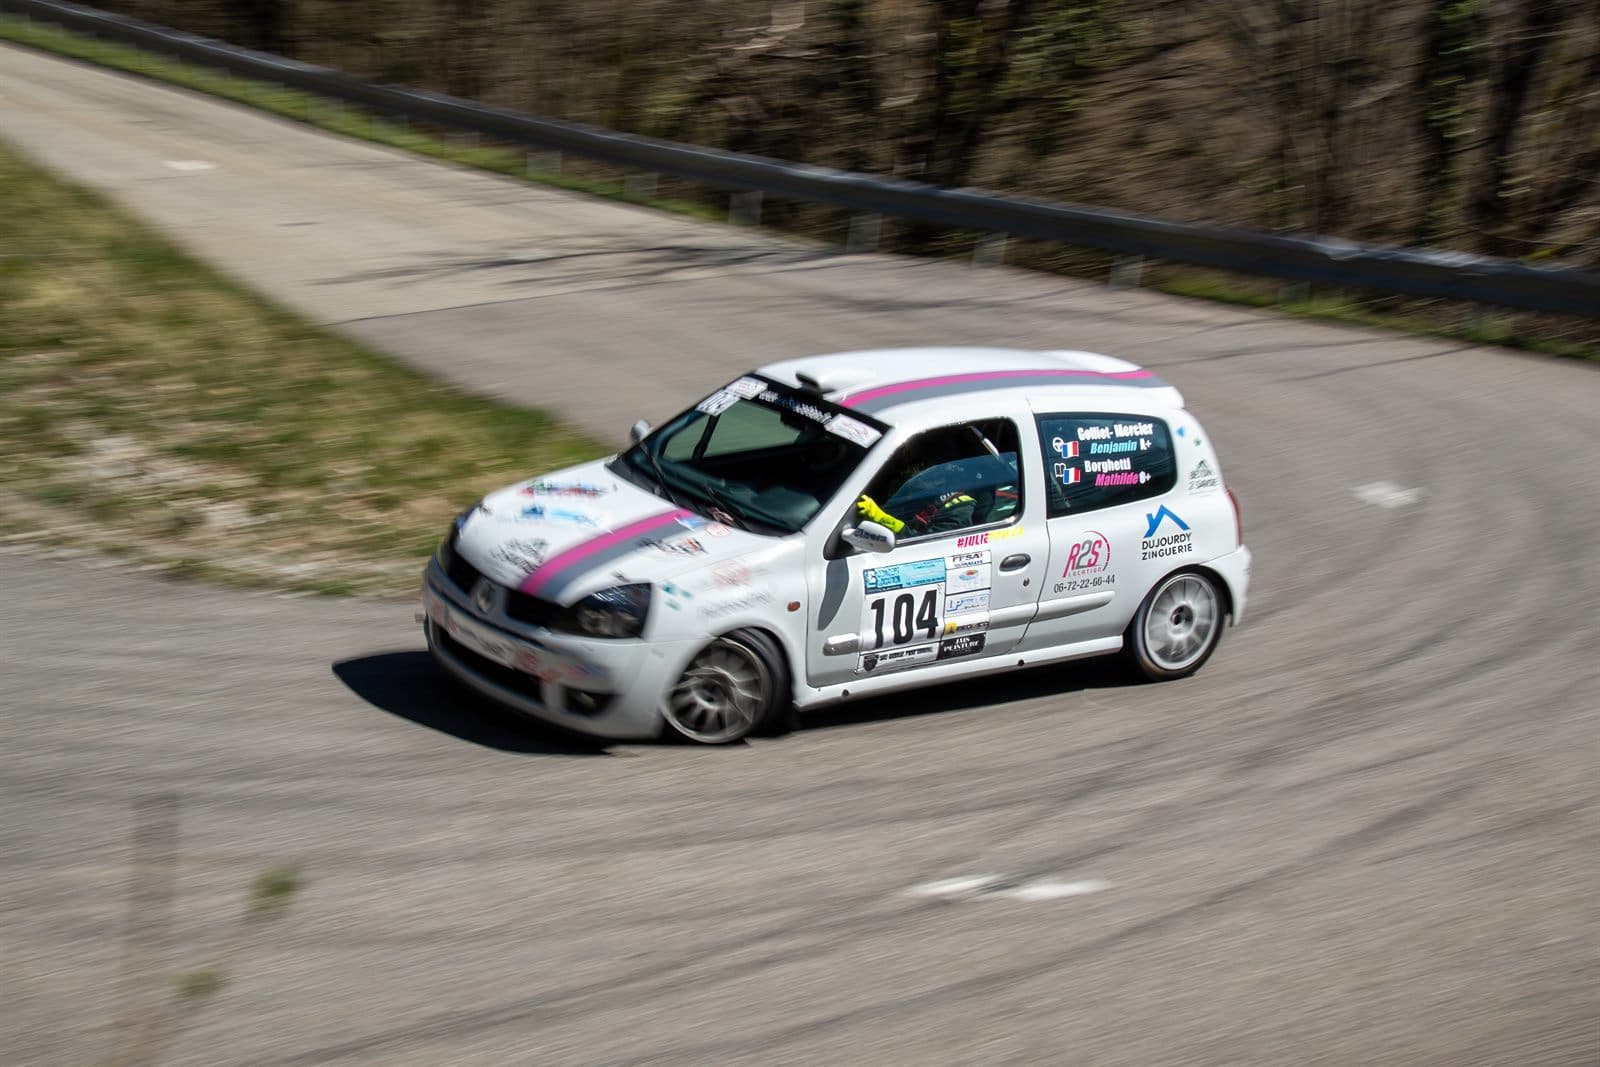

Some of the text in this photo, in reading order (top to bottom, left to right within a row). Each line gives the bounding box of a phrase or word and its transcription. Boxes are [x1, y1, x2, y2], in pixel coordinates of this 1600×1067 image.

[1090, 440, 1137, 455] Benjamin
[1084, 457, 1131, 473] Borghetti
[1095, 472, 1139, 487] Mathilde
[1141, 532, 1192, 551] DUJOURDY
[953, 552, 984, 563] FFSA
[1062, 539, 1103, 578] R2S
[1141, 543, 1193, 561] ZINGUERIE
[1053, 574, 1116, 593] 06-72-22-66-44
[870, 589, 939, 649] 104
